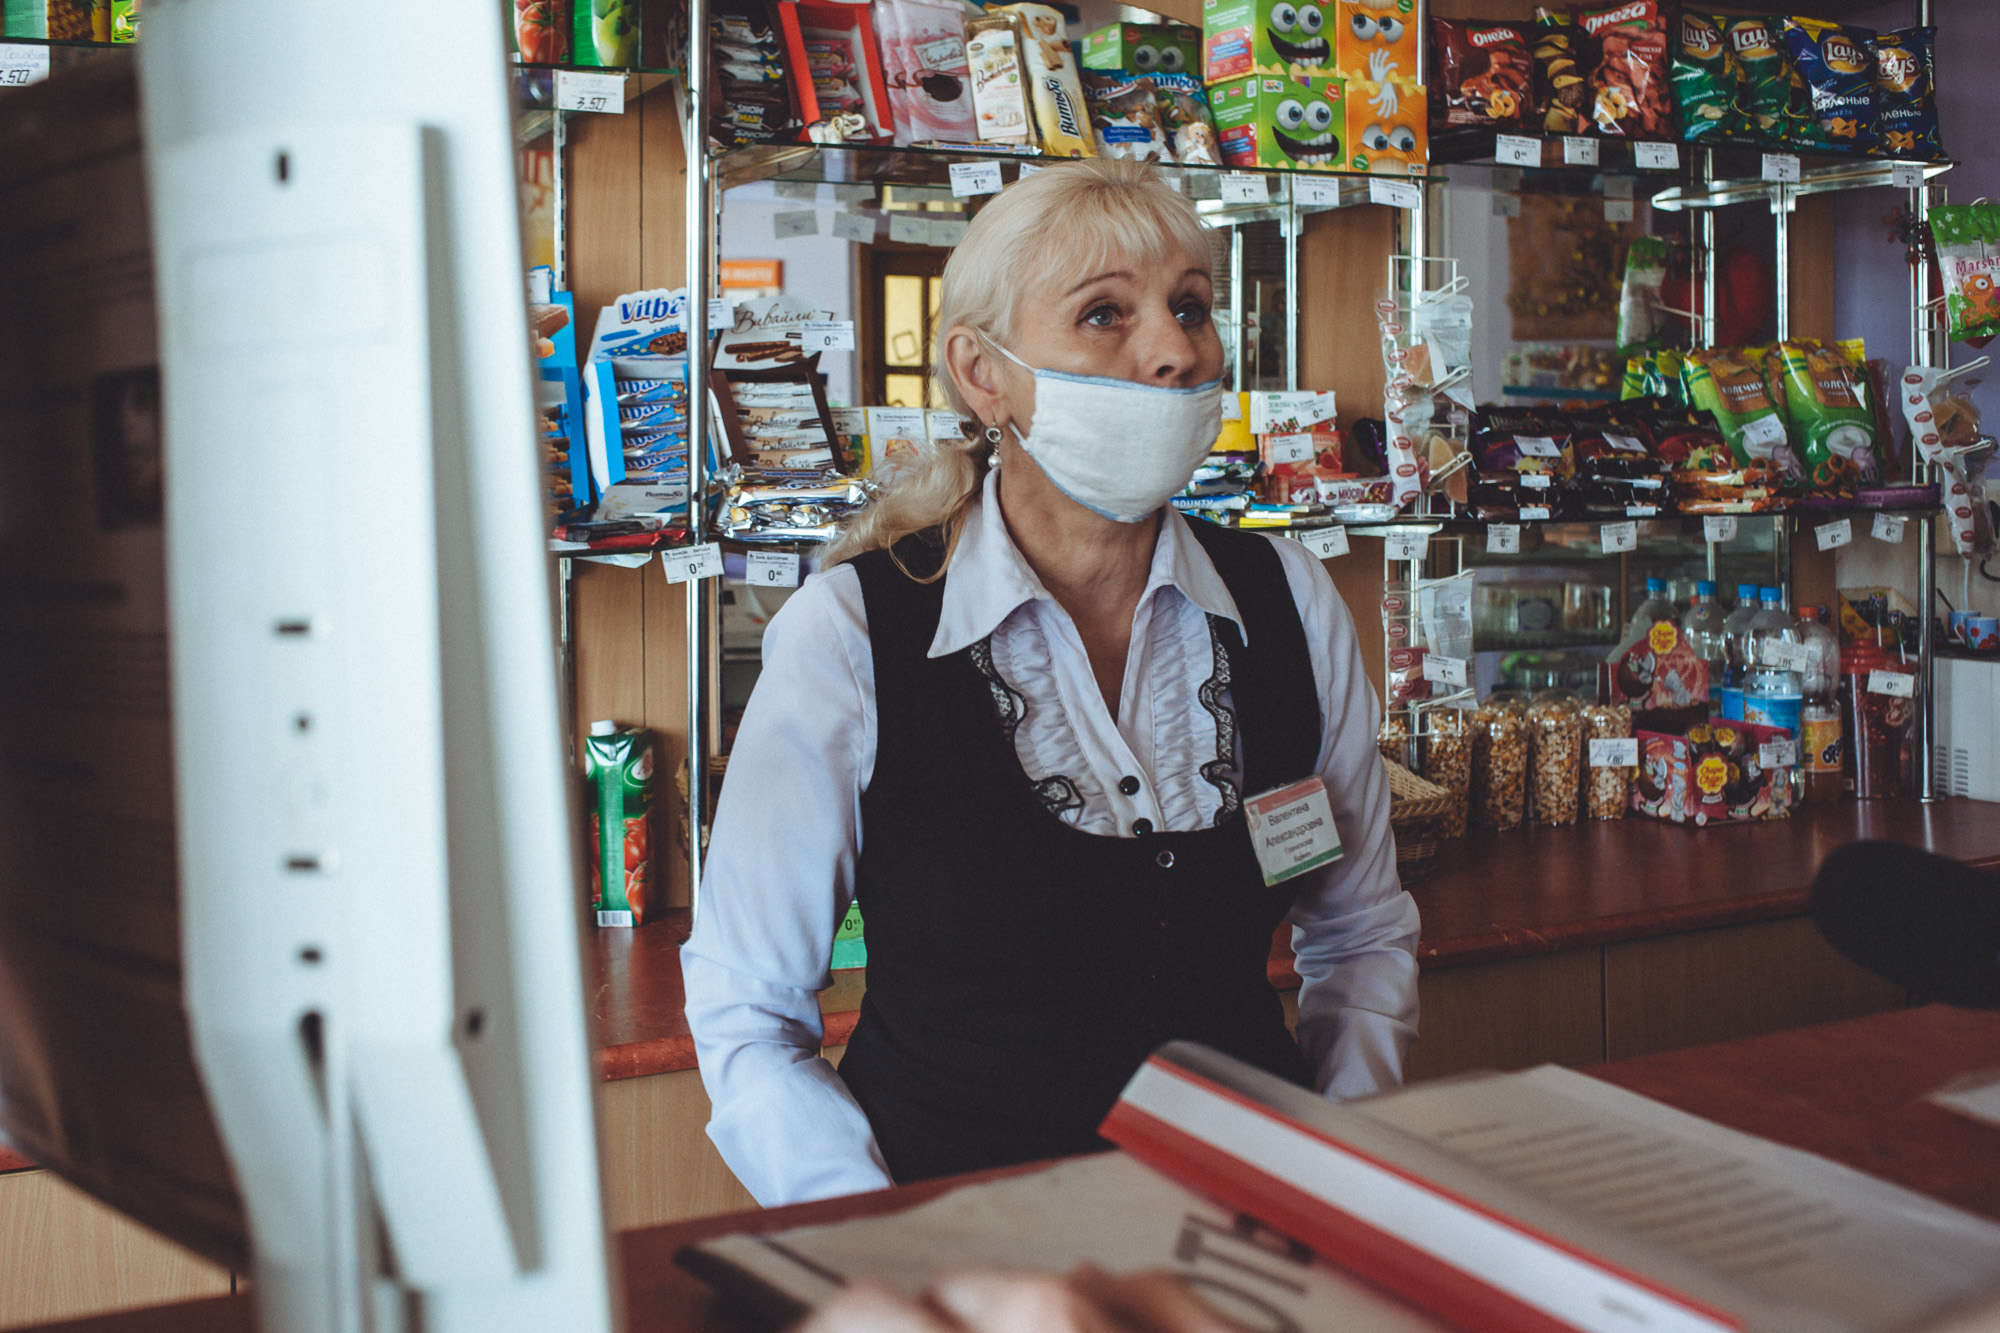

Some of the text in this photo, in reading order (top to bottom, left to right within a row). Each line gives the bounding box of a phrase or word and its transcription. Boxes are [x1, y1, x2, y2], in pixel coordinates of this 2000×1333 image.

[1585, 3, 1647, 35] Онега
[1472, 28, 1515, 47] Онега
[1682, 20, 1717, 52] Lay's
[1172, 499, 1213, 507] BOUNTY
[845, 919, 853, 931] 0
